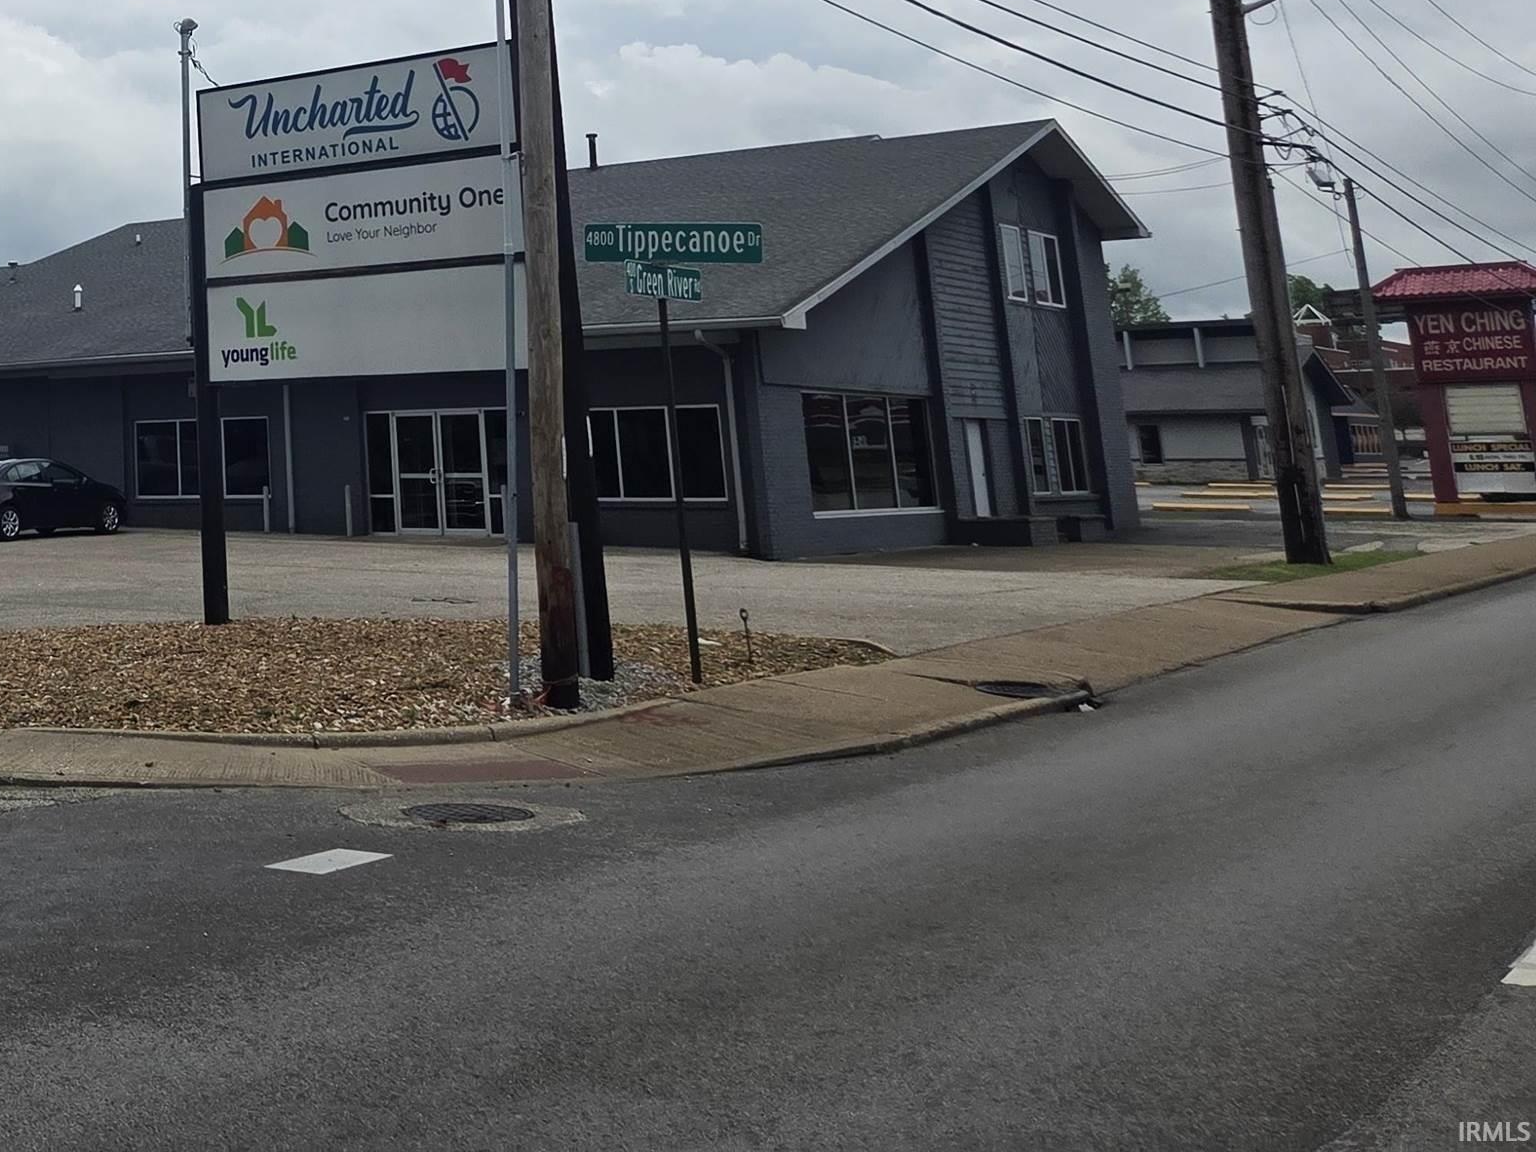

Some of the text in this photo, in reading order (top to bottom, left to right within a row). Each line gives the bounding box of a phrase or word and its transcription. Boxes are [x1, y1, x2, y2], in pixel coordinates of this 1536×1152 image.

[229, 70, 419, 140] Uncharted
[251, 137, 399, 168] INTERNATIONAL
[324, 186, 504, 223] Community One
[327, 222, 438, 243] Love Your Neighbor
[586, 225, 761, 259] 4800 Tippecanoe Dr
[636, 264, 664, 296] Green
[667, 268, 693, 299] River
[1414, 310, 1526, 335] YEN CHING
[1463, 335, 1523, 351] CHINESE
[1422, 356, 1528, 372] RESTAURANT
